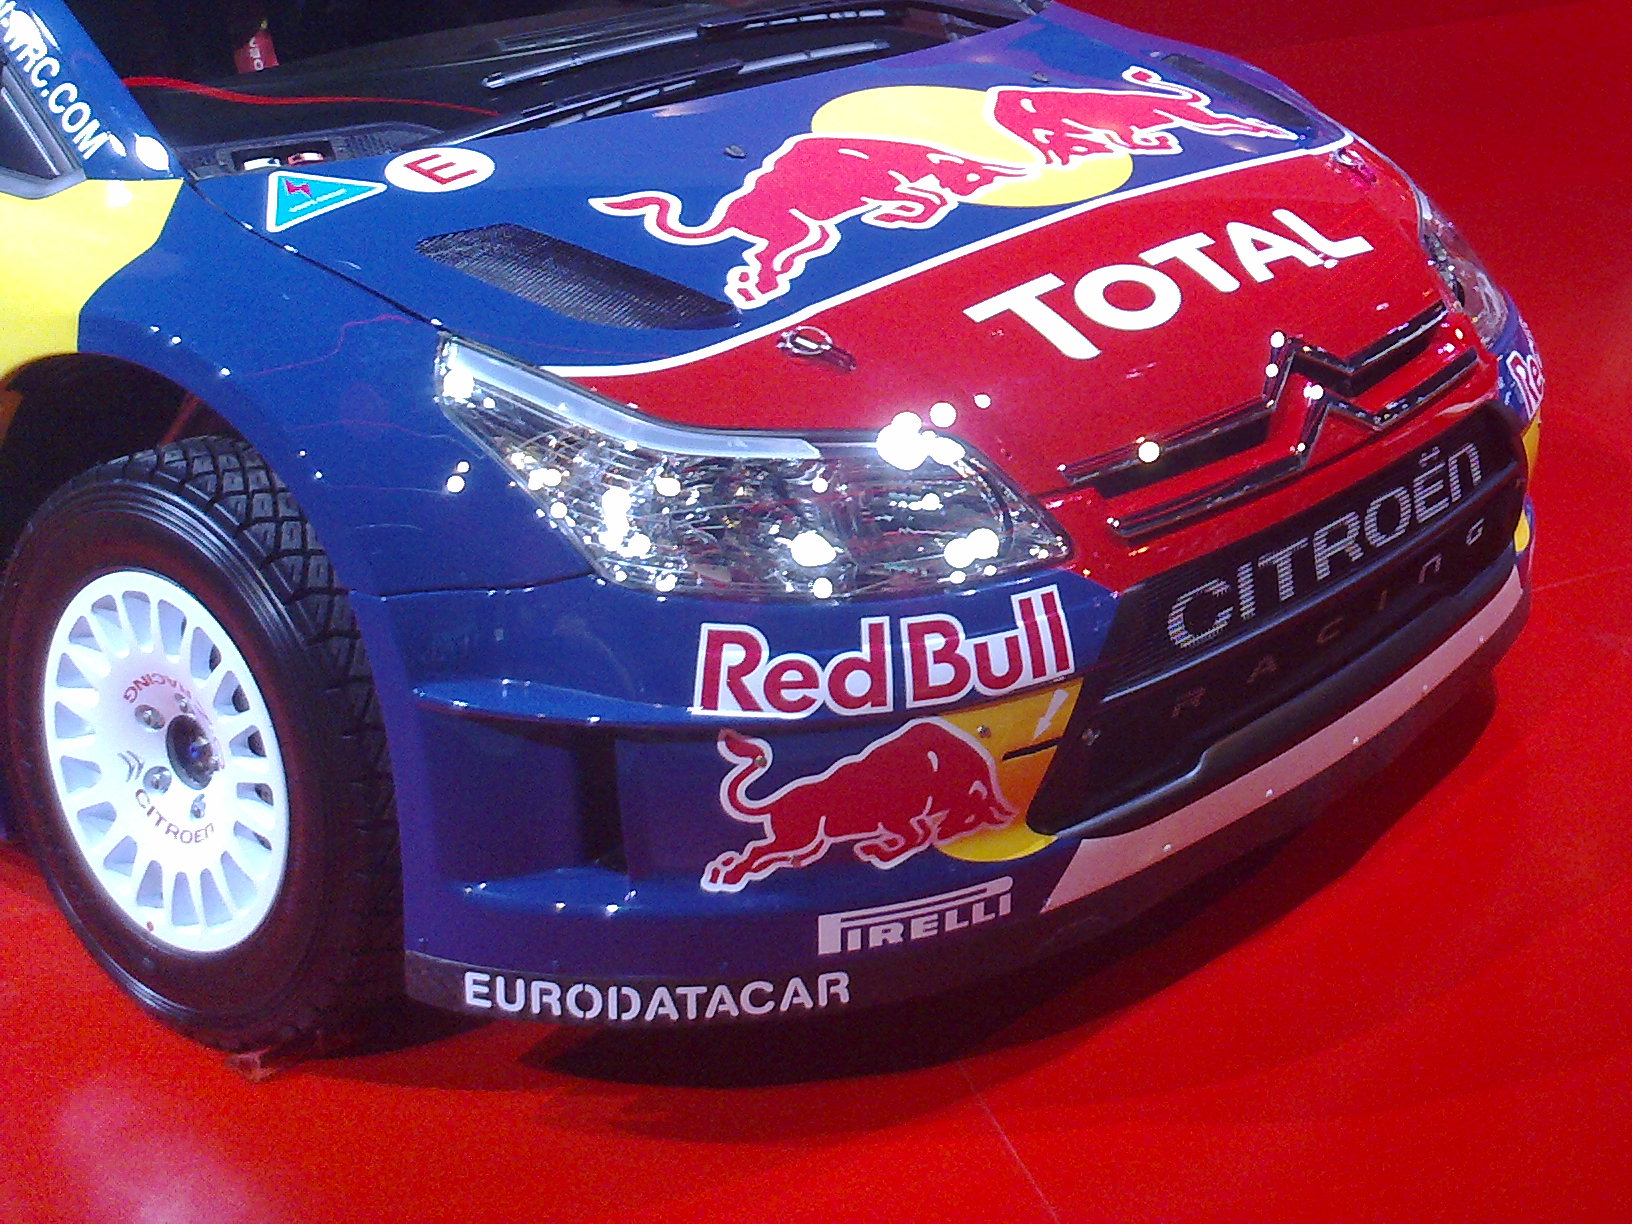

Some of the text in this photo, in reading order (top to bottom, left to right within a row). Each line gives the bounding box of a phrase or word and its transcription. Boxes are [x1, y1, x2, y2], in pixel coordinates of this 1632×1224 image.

[403, 153, 478, 185] E
[963, 208, 1374, 361] TOTAL
[1166, 442, 1482, 650] CITROËN
[695, 586, 1075, 716] Red Bull
[817, 877, 1014, 956] PIRELLI
[464, 971, 851, 1022] EURODATACAR
